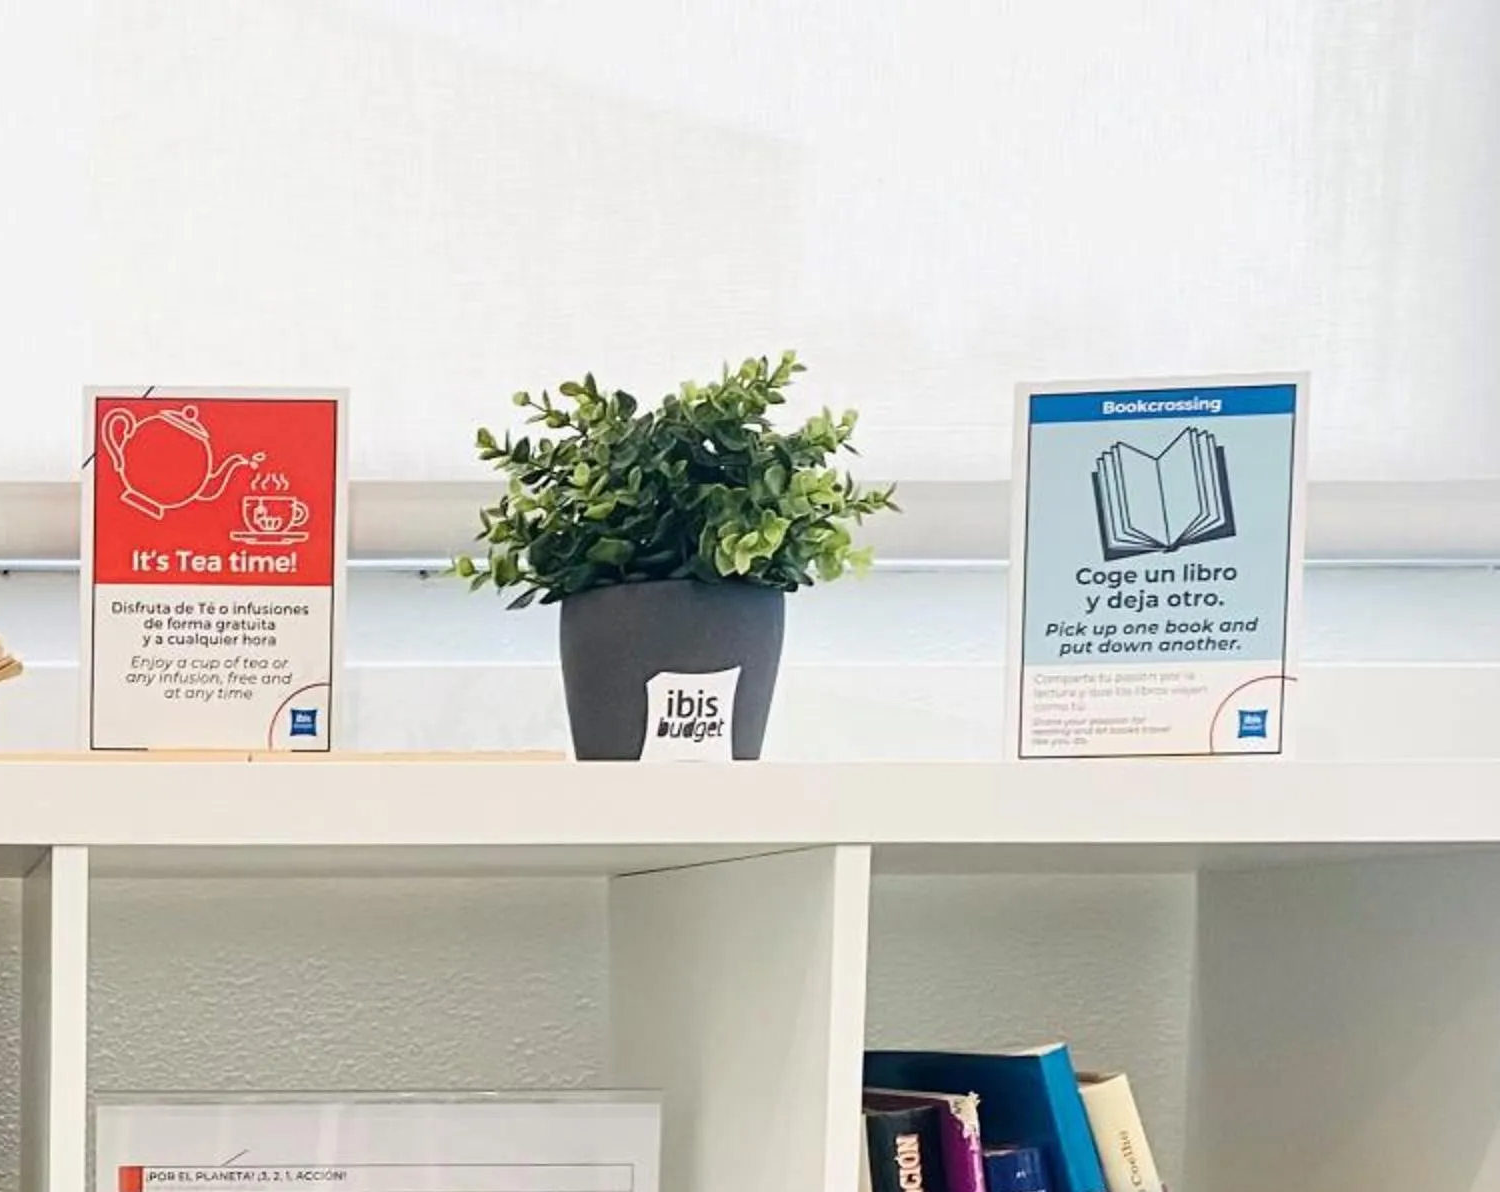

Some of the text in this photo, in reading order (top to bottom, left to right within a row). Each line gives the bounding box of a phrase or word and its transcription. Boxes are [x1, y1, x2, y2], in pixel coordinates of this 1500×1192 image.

[1102, 397, 1222, 415] Bookcrossing
[132, 550, 297, 574] It's Tea time!
[1076, 564, 1238, 589] Coge un libro
[111, 601, 309, 616] Disfruta de infusiones
[1086, 591, 1225, 614] y deja otro.
[144, 617, 277, 634] de forma gratuita
[1045, 617, 1259, 640] Pick up one book and
[168, 633, 277, 648] cualquier hora
[1059, 636, 1242, 657] put down another.
[131, 656, 289, 673] Enjoy cup of tea or
[125, 671, 292, 687] any infusion, free and
[164, 687, 253, 703] at any time
[667, 690, 718, 718] ibis
[657, 718, 725, 742] budget
[1119, 1130, 1141, 1187] Coelho
[179, 1171, 193, 1181] EL
